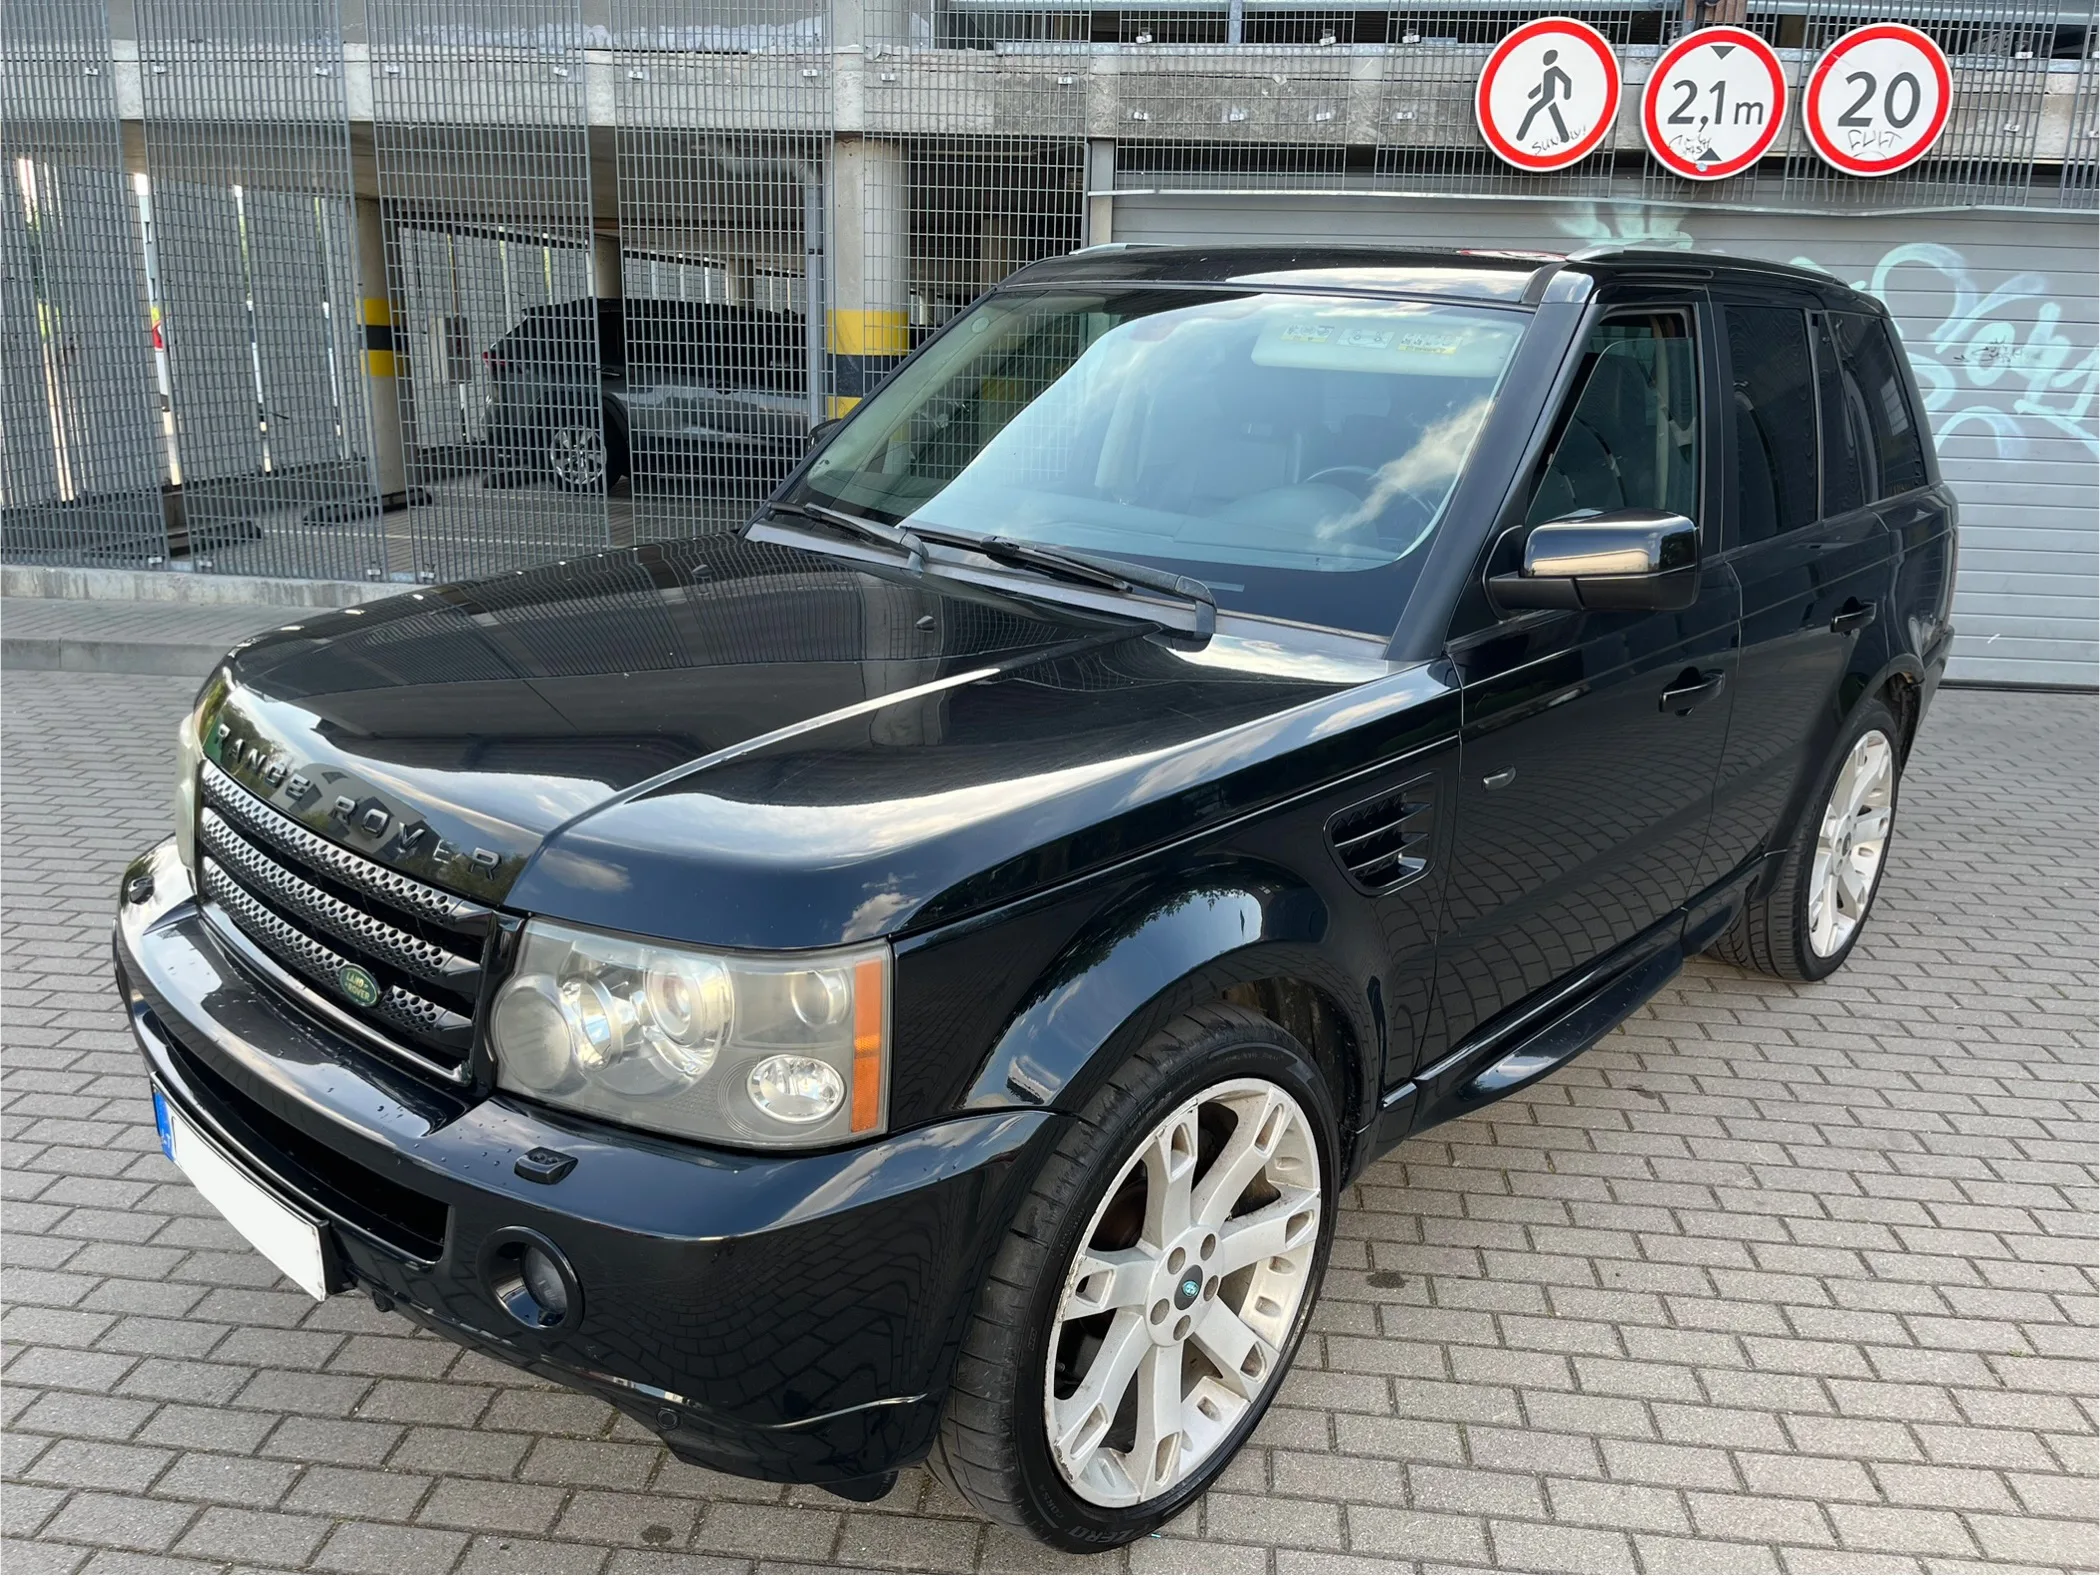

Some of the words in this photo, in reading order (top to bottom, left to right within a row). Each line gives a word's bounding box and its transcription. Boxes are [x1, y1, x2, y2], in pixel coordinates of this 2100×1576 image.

[1667, 79, 1726, 133] 2,1
[1733, 101, 1764, 125] m
[1837, 71, 1921, 129] 20
[216, 723, 314, 801] RANGE
[329, 795, 501, 881] ROVER
[346, 971, 365, 988] LAND
[347, 983, 371, 1001] ROVER
[1067, 1525, 1135, 1544] ZERO
